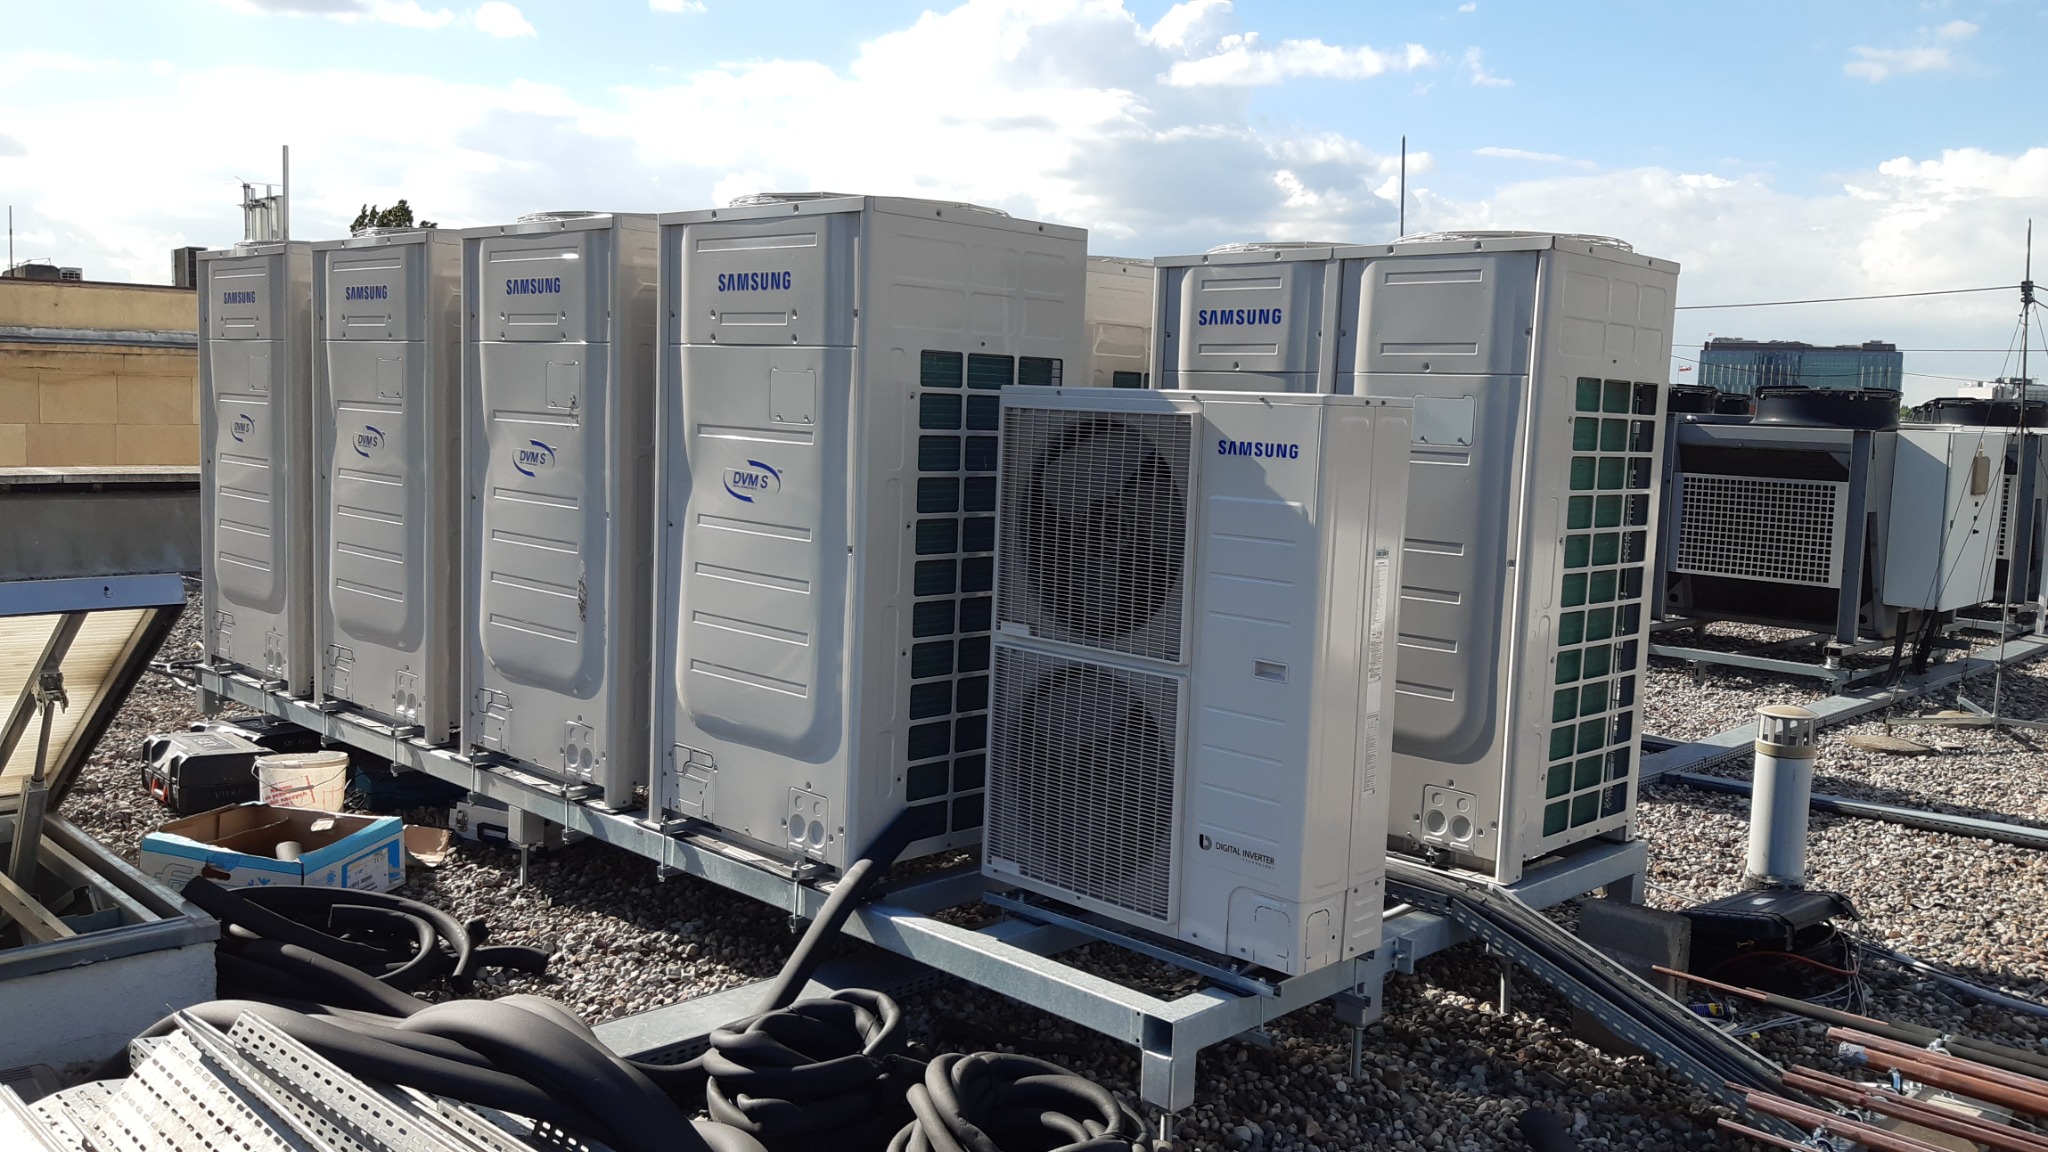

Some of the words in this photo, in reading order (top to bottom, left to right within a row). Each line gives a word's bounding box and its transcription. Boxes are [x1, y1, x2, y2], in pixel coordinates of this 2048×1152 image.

[506, 277, 561, 295] SAMSUNG
[718, 270, 792, 292] SAMSUNG
[223, 291, 256, 304] SAMSUNG
[345, 285, 388, 300] SAMSUNG
[1198, 308, 1282, 326] SAMSUNG
[358, 434, 372, 446] DVM
[373, 436, 378, 447] S
[1217, 439, 1299, 459] SAMSUNG
[520, 450, 539, 463] DVM
[540, 452, 546, 465] S
[733, 471, 759, 487] DVM
[760, 475, 769, 489] S
[1215, 842, 1241, 856] DIGITAL
[1242, 849, 1275, 865] INVERTER
